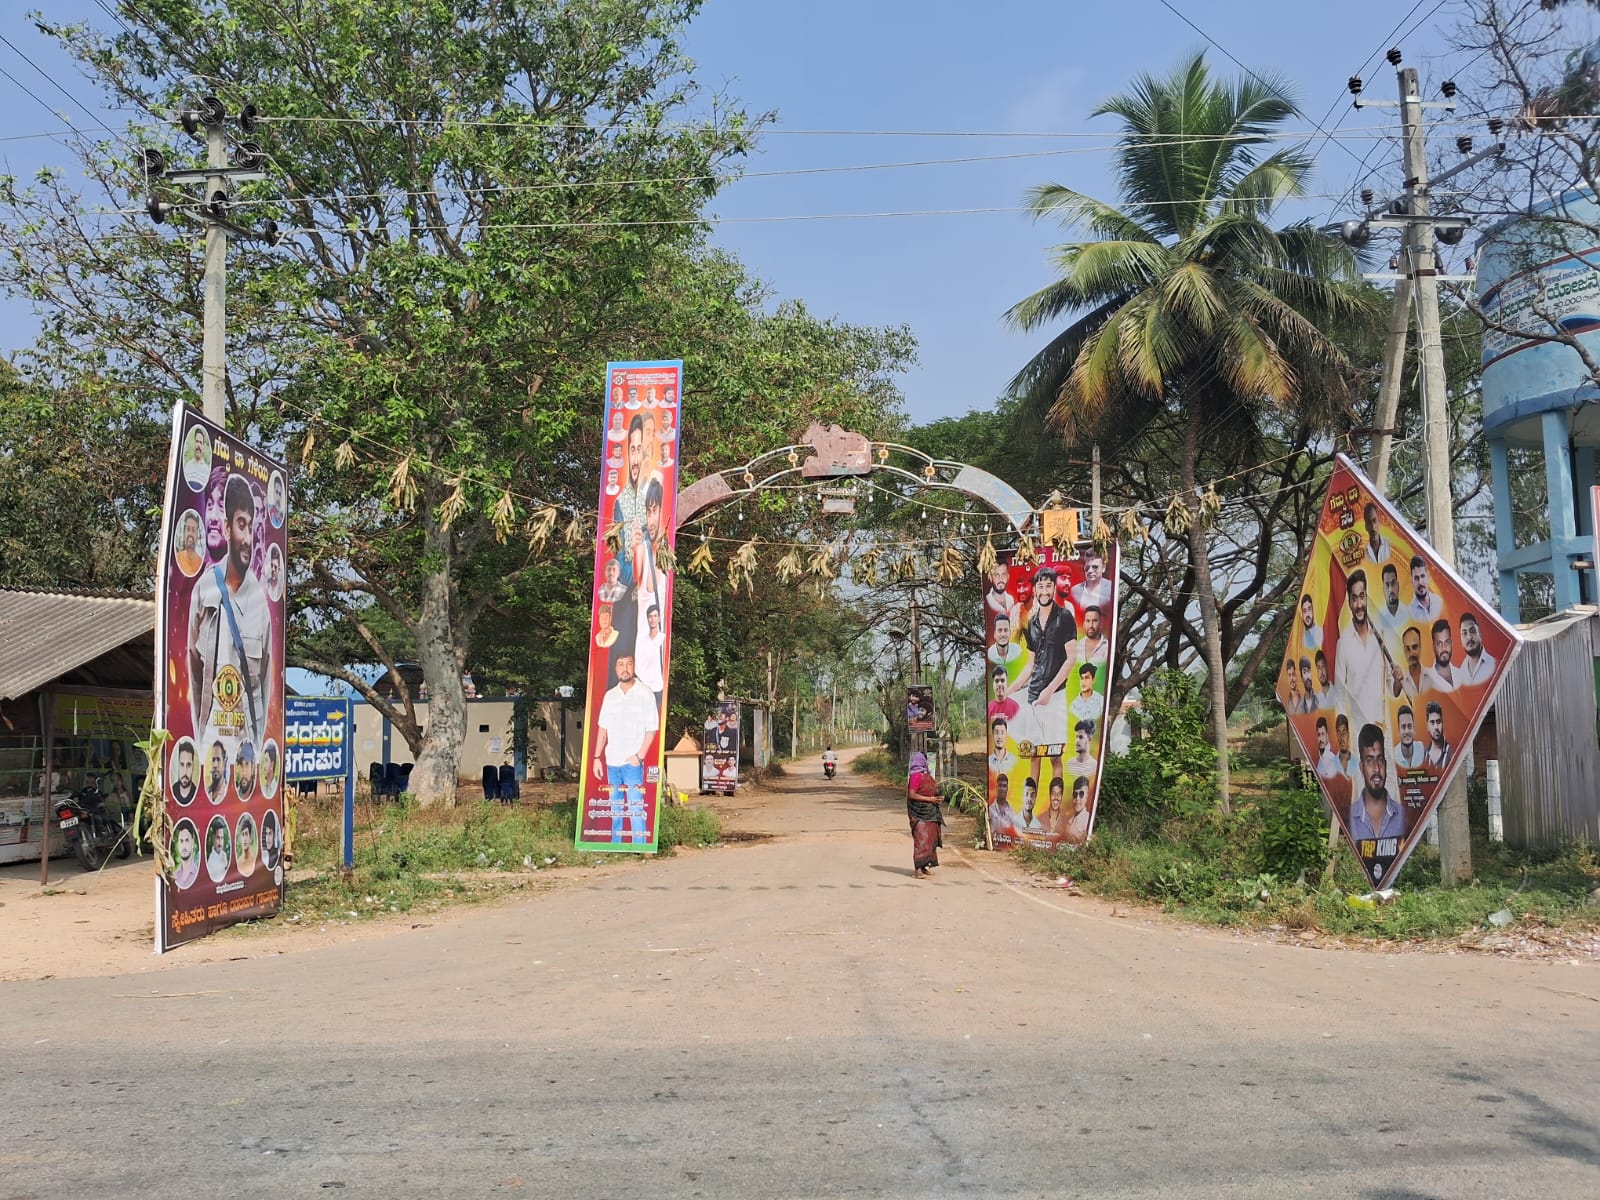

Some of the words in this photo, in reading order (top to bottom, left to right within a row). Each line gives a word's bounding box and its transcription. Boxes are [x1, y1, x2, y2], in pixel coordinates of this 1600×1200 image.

[234, 451, 245, 468] ಬಾ
[213, 710, 227, 726] BIGG
[228, 711, 245, 727] BOSS
[1361, 840, 1376, 858] TRP
[1376, 838, 1397, 856] KING
[207, 900, 228, 919] ಹಾಗೂ
